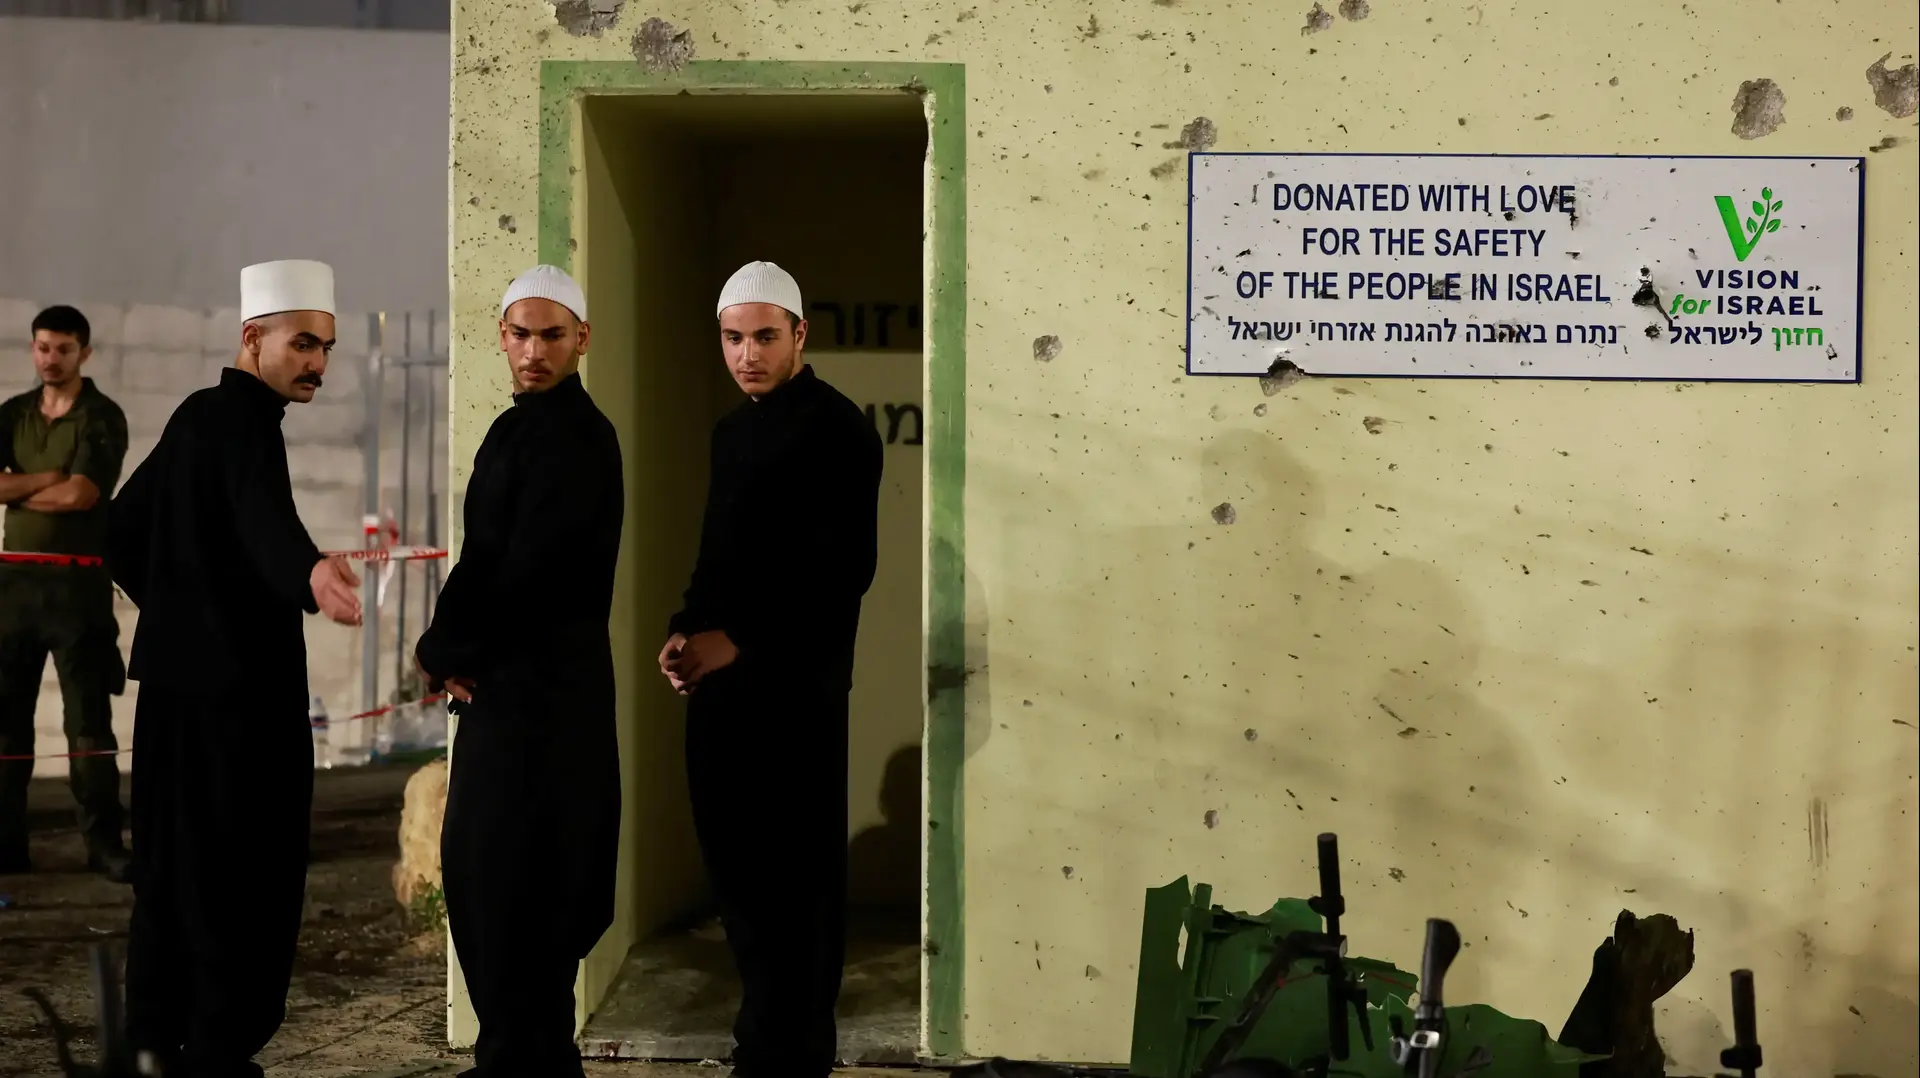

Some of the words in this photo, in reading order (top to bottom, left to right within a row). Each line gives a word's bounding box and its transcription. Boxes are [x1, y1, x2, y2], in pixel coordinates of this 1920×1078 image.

[1273, 183, 1410, 212] DONATED
[1418, 184, 1490, 212] WITH
[1500, 184, 1576, 213] LOVE
[1303, 227, 1361, 256] FOR
[1369, 228, 1425, 256] THE
[1434, 228, 1547, 257] SAFETY
[1236, 271, 1274, 299] OF
[1283, 271, 1339, 300] THE
[1348, 272, 1462, 301] PEOPLE
[1471, 273, 1498, 301] IN
[1508, 273, 1611, 302] ISRAEL
[1695, 269, 1799, 290] VISION
[1668, 294, 1712, 315] for
[1717, 295, 1824, 316] ISRAEL
[1227, 316, 1302, 341] ישראל
[1310, 320, 1376, 342] אזרחי
[1384, 318, 1457, 342] להגנת
[1466, 322, 1548, 343] באהבה
[1556, 324, 1618, 344] נתרם
[1668, 320, 1763, 345] לישראל
[1771, 327, 1824, 352] חזון
